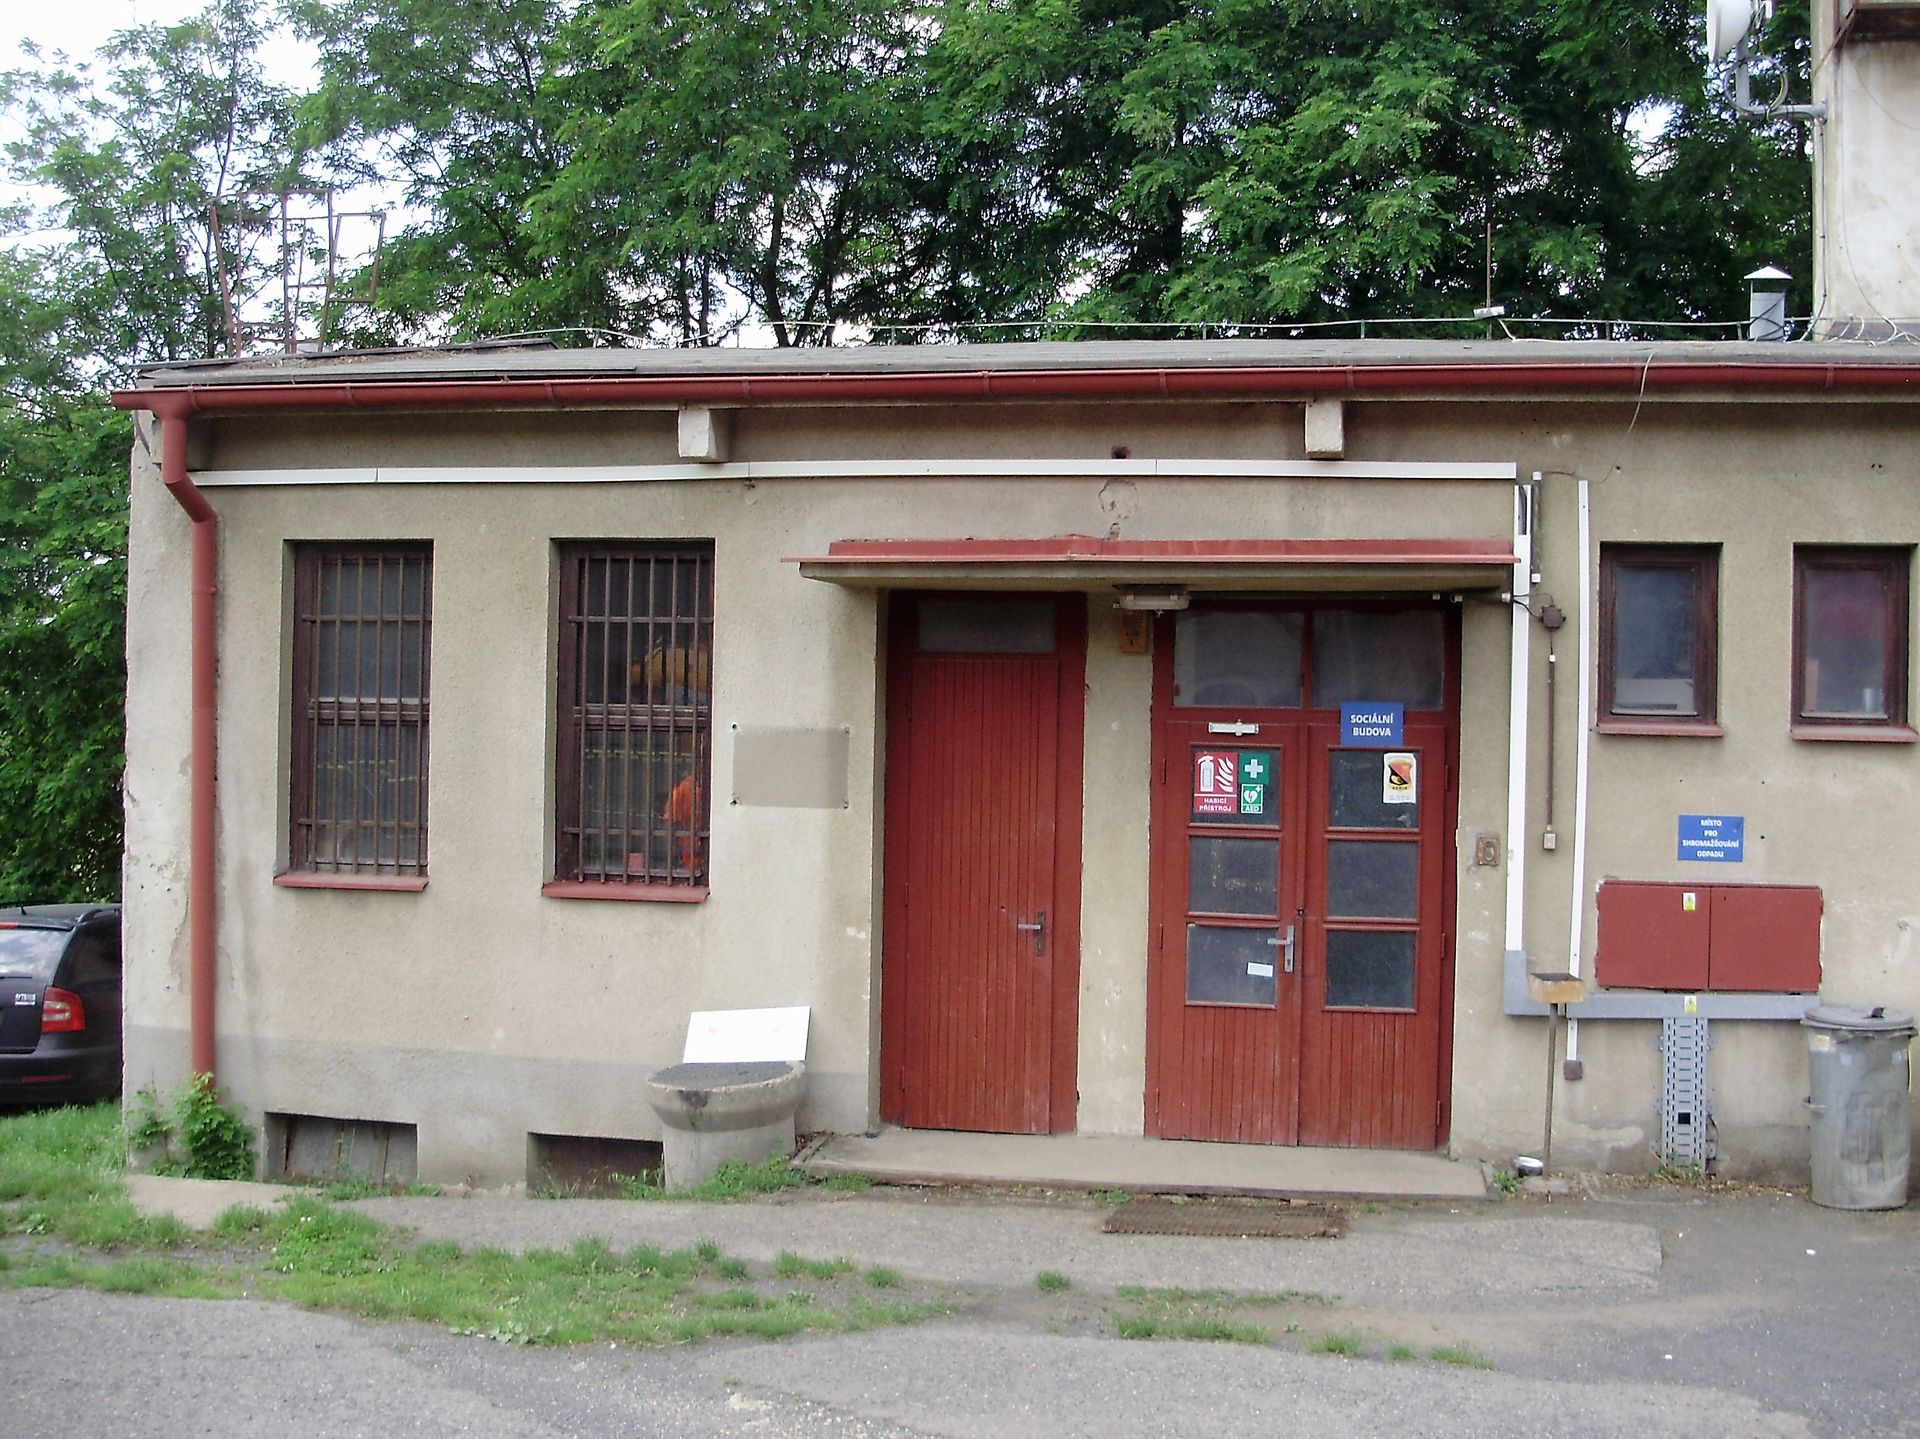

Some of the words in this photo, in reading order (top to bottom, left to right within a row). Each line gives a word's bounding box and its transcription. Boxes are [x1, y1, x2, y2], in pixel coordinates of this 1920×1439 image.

[1350, 712, 1394, 724] SOCIÁLNÍ
[1353, 727, 1391, 737] BUDOVA
[1700, 818, 1722, 827] MÍSTO
[1696, 850, 1724, 858] ODPADU
